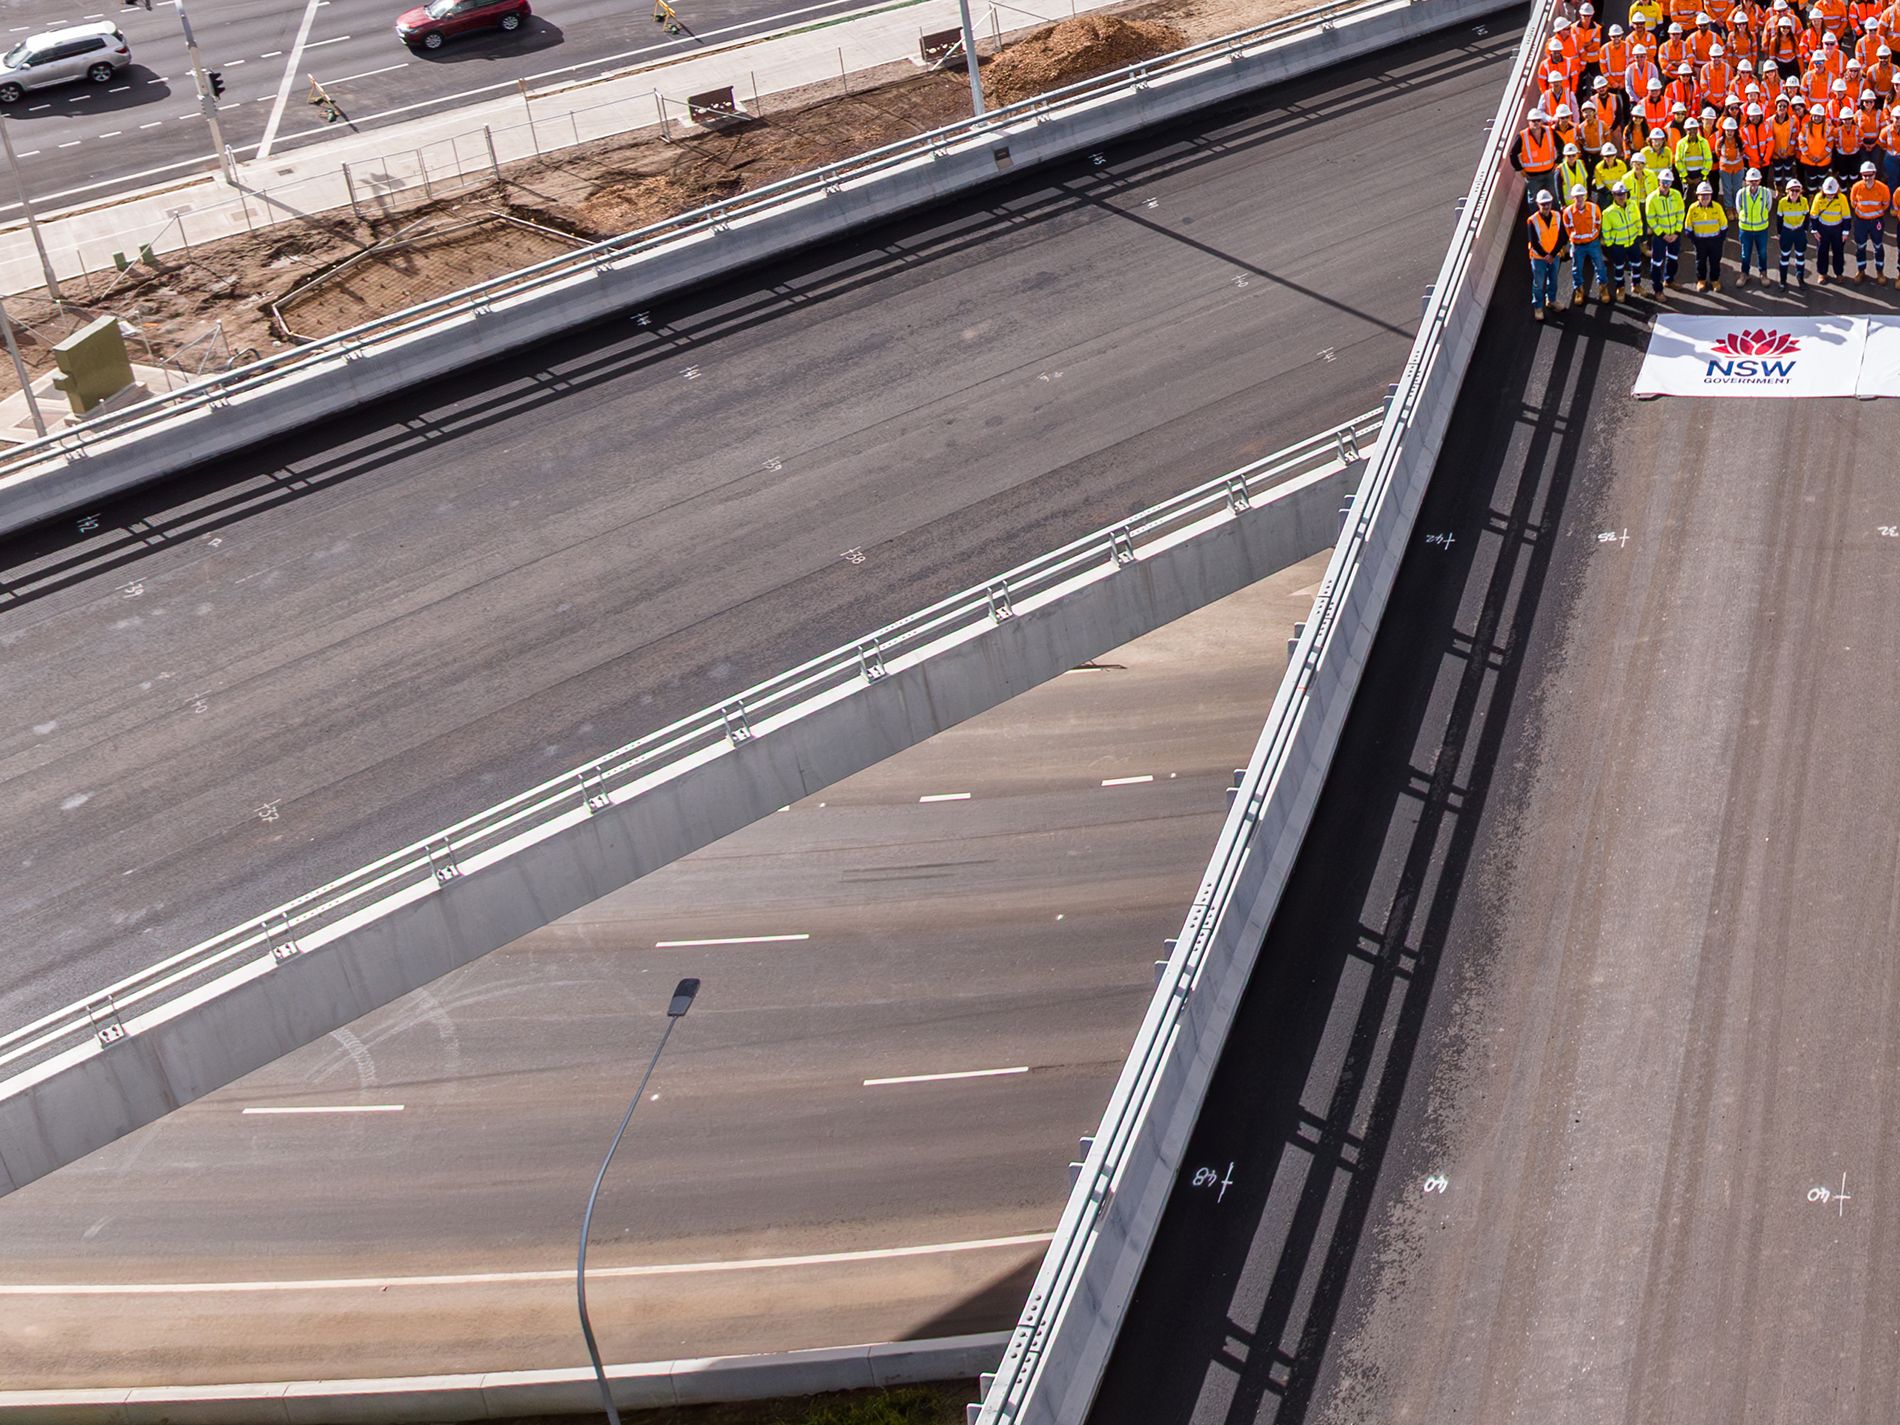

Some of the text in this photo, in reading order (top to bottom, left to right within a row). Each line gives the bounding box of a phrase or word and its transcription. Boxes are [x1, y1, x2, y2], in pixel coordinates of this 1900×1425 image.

[1706, 359, 1797, 377] NSW
[1703, 377, 1793, 385] GOVERNMENT
[1192, 1166, 1217, 1186] 48
[1807, 1185, 1830, 1203] 40
